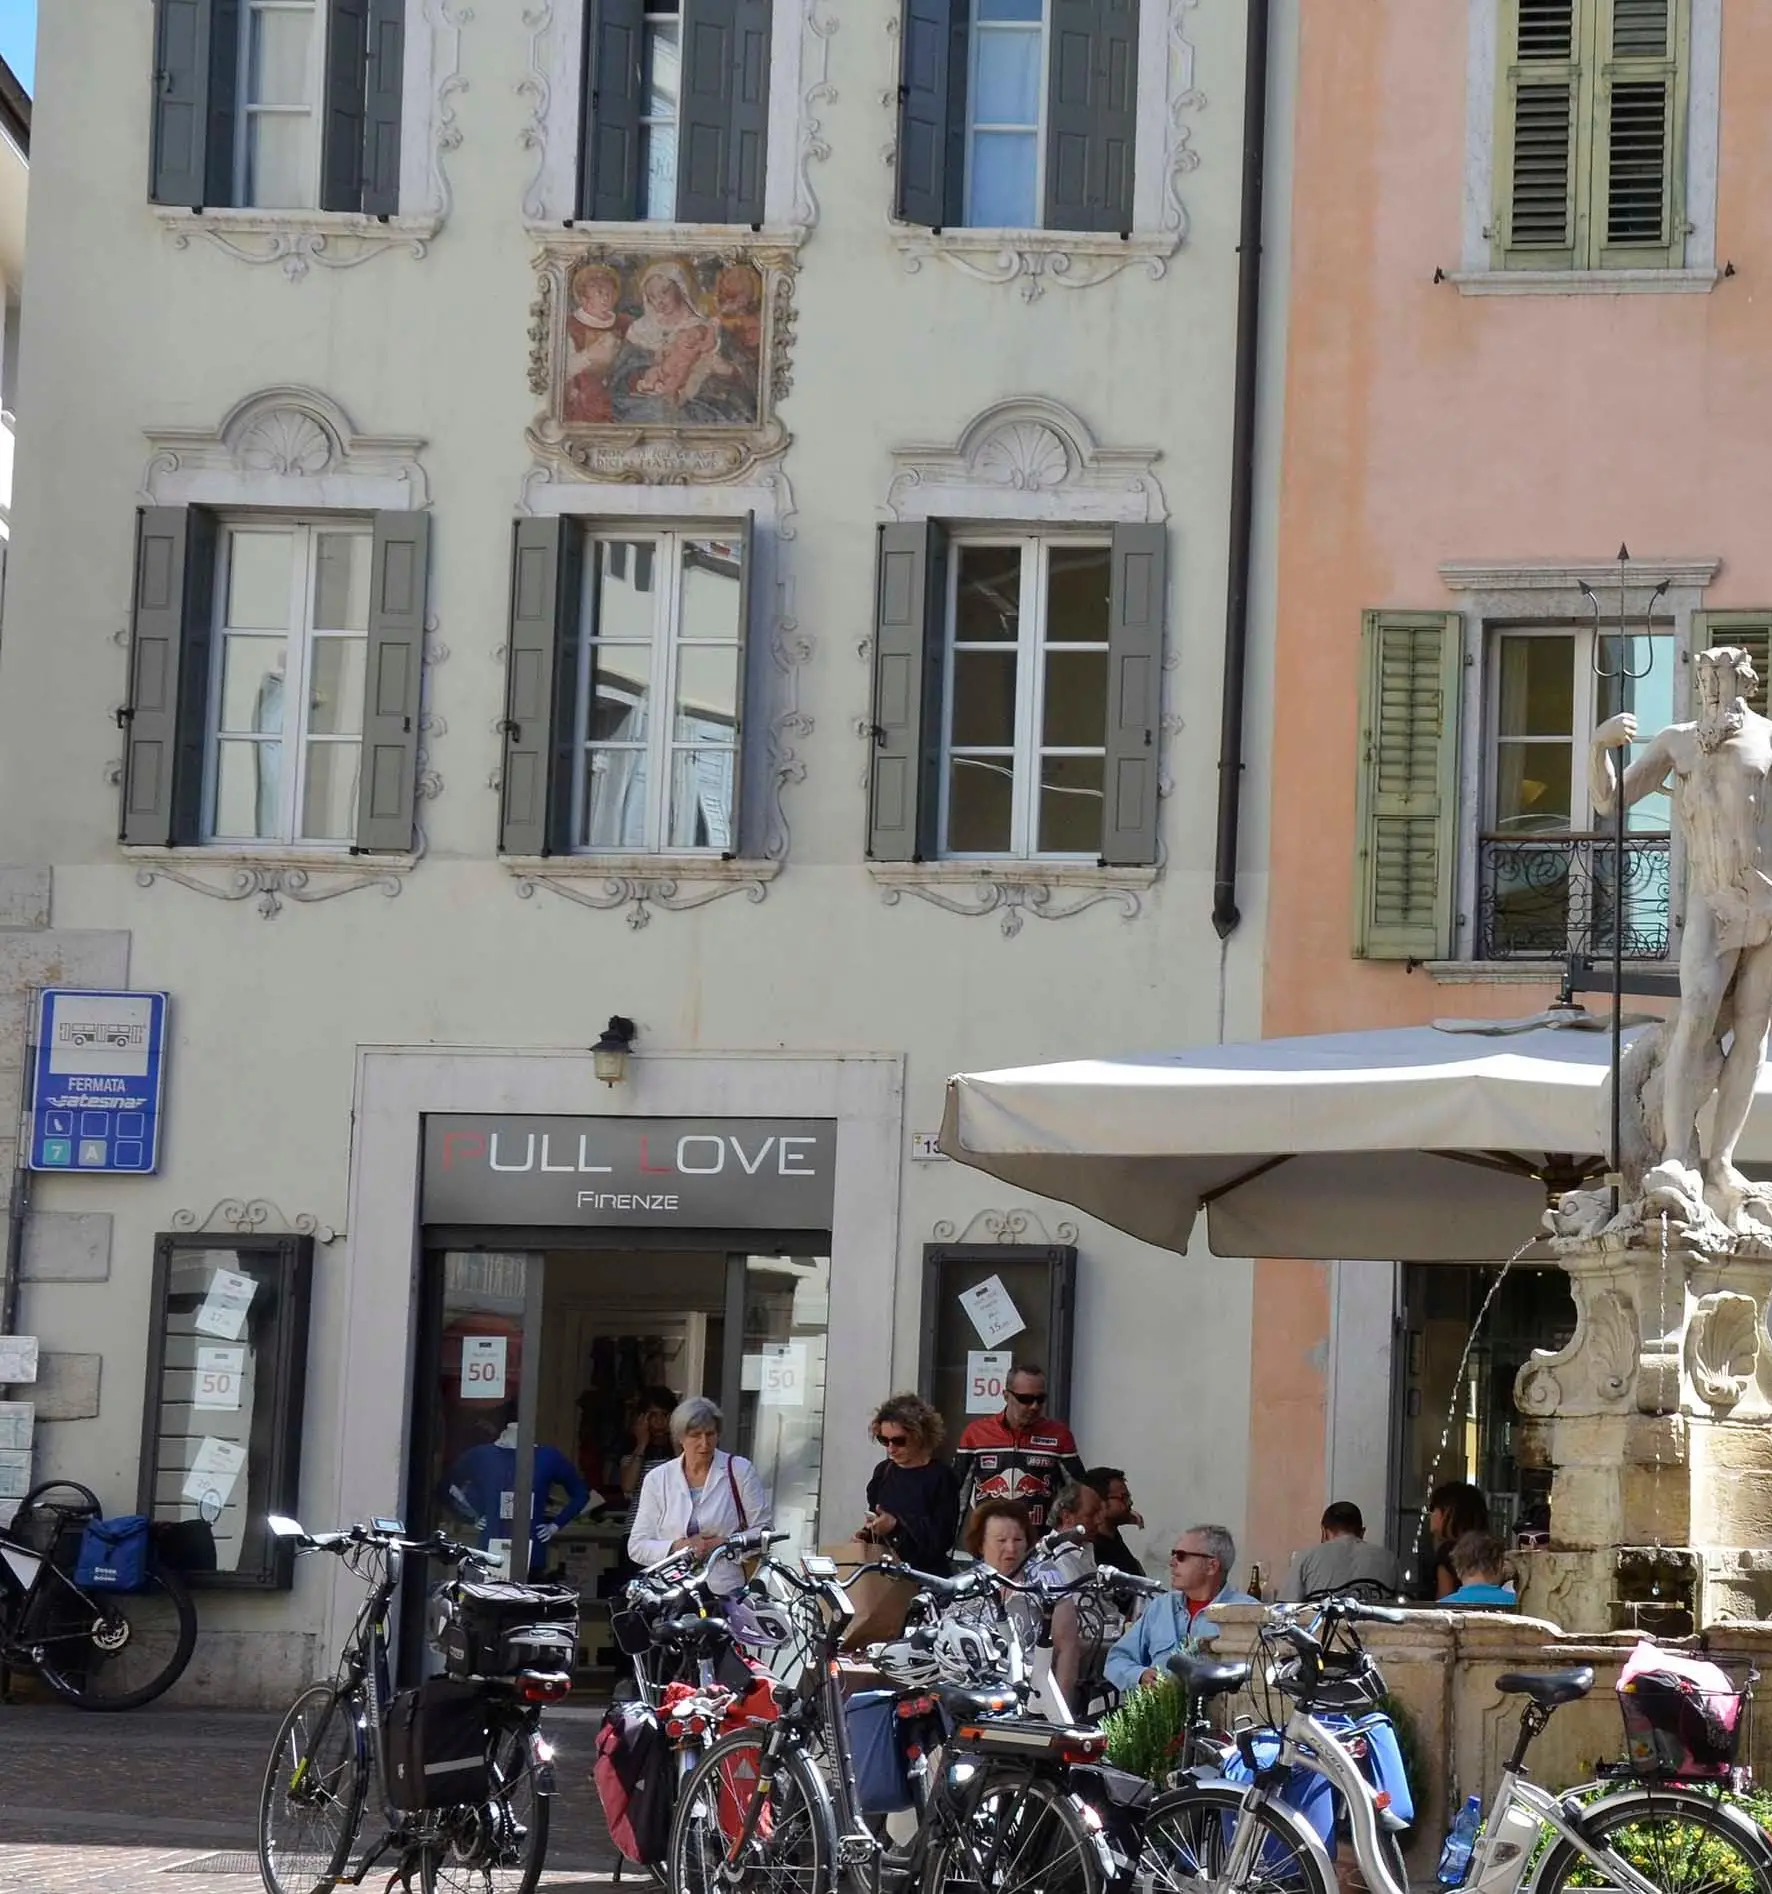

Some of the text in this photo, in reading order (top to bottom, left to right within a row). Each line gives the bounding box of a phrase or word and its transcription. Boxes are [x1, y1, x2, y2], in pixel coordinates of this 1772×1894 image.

[68, 1077, 126, 1092] FERMATA
[51, 1145, 98, 1160] 7 A
[442, 1131, 817, 1175] PULL LOVE
